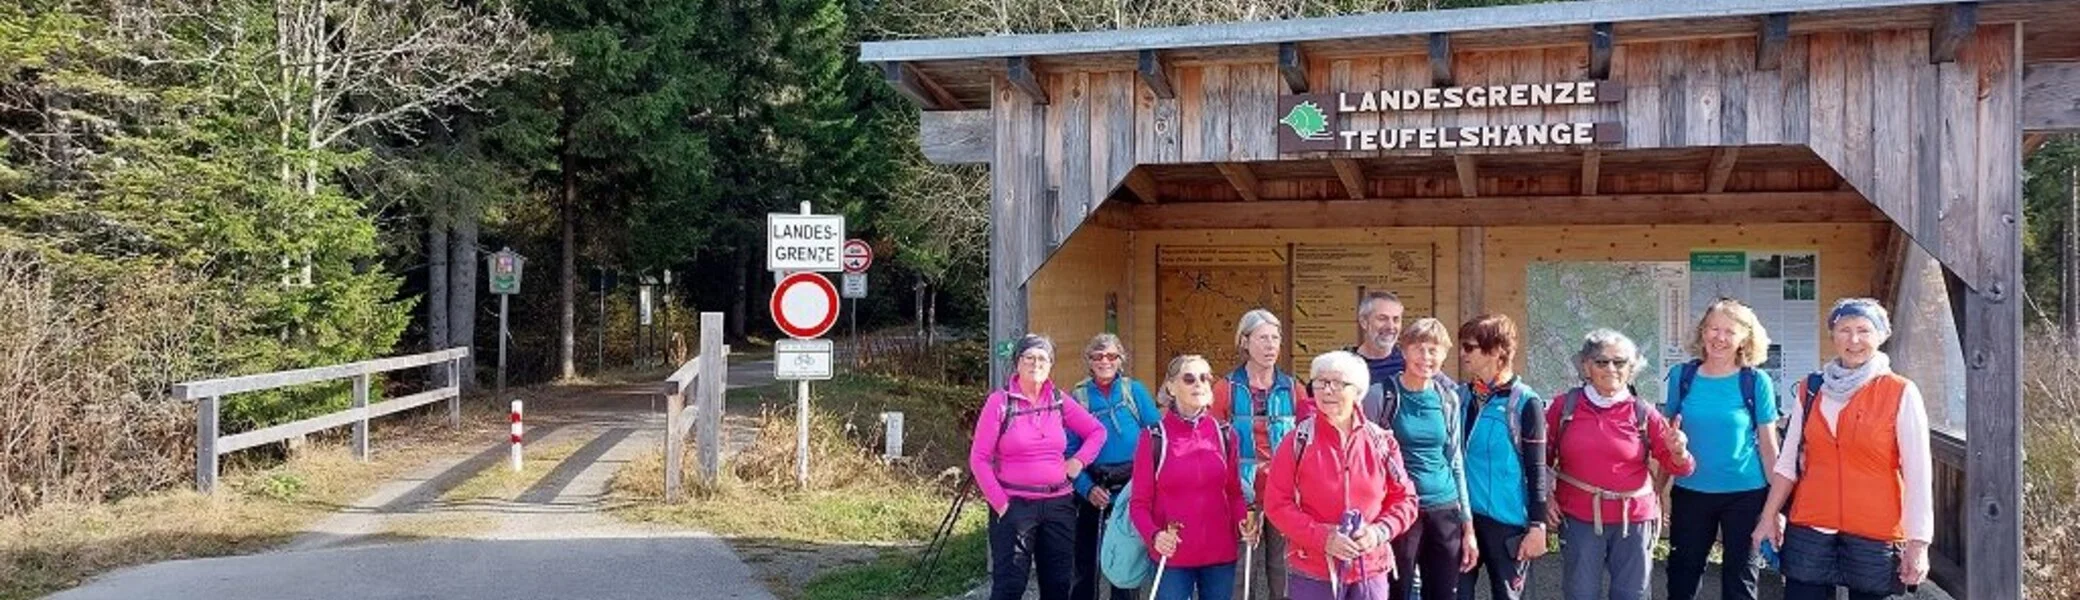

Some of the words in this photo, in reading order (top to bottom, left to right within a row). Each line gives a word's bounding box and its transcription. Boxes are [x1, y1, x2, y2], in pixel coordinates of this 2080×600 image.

[1339, 82, 1596, 112] LANDESGRENZE
[1340, 123, 1594, 150] TEUFELSHÄNGE
[773, 224, 838, 240] LANDES-
[775, 246, 835, 262] GRENZE
